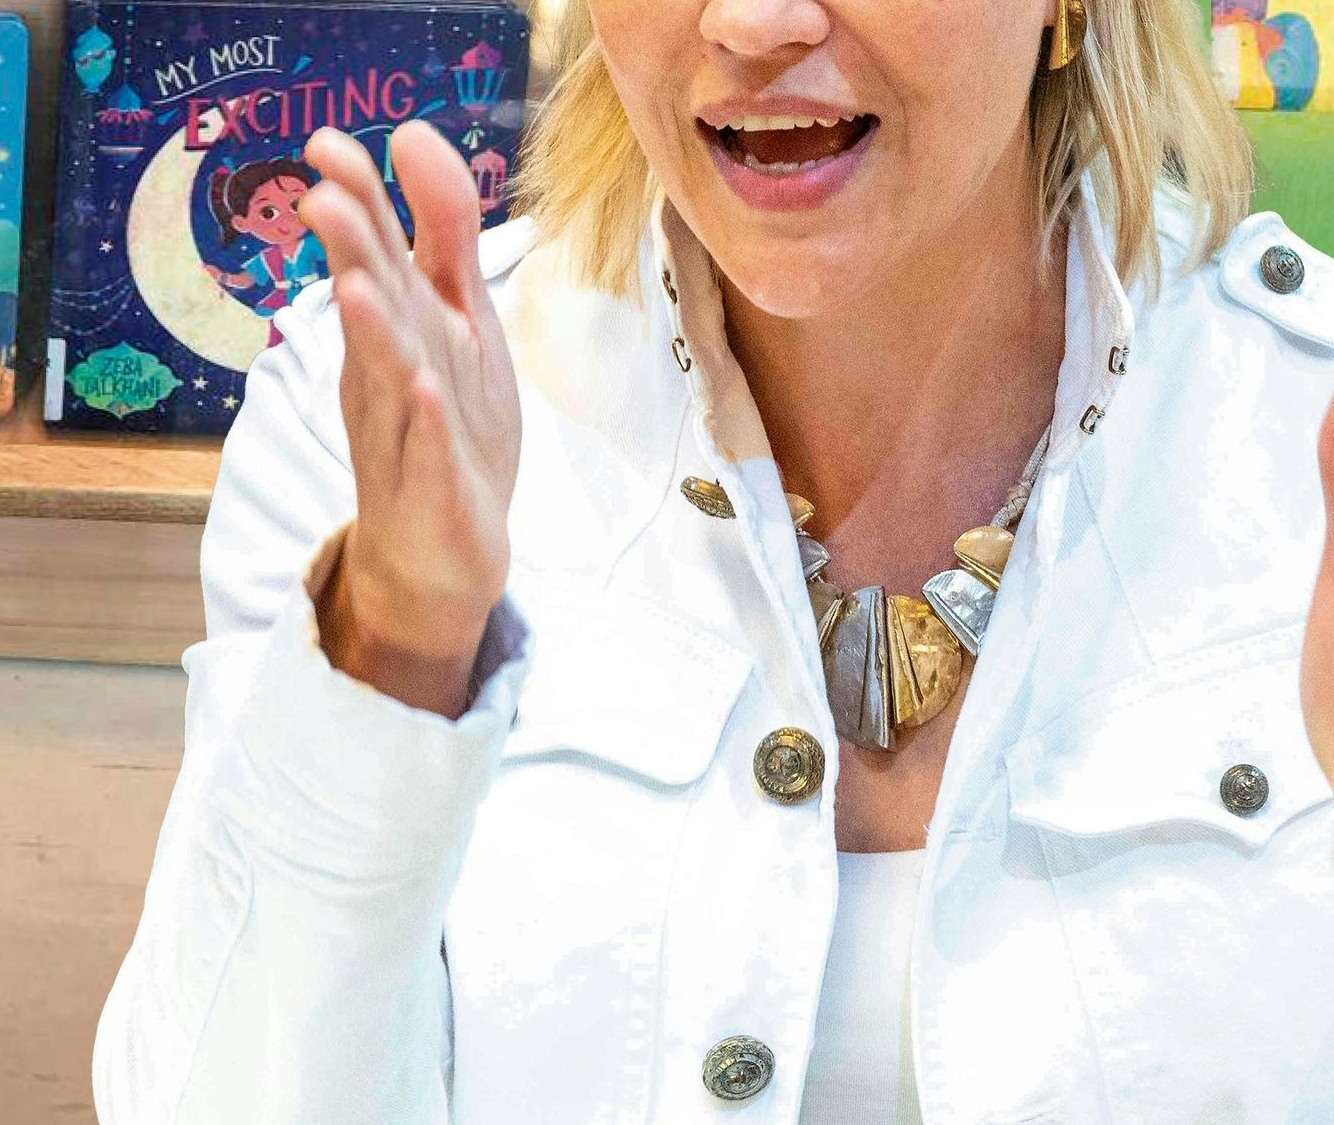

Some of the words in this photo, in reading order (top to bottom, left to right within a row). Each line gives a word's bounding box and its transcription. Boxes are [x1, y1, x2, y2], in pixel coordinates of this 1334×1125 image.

[154, 57, 196, 96] MY
[209, 35, 280, 78] MOST
[183, 68, 416, 152] EXCITING
[100, 356, 143, 377] ZEBA
